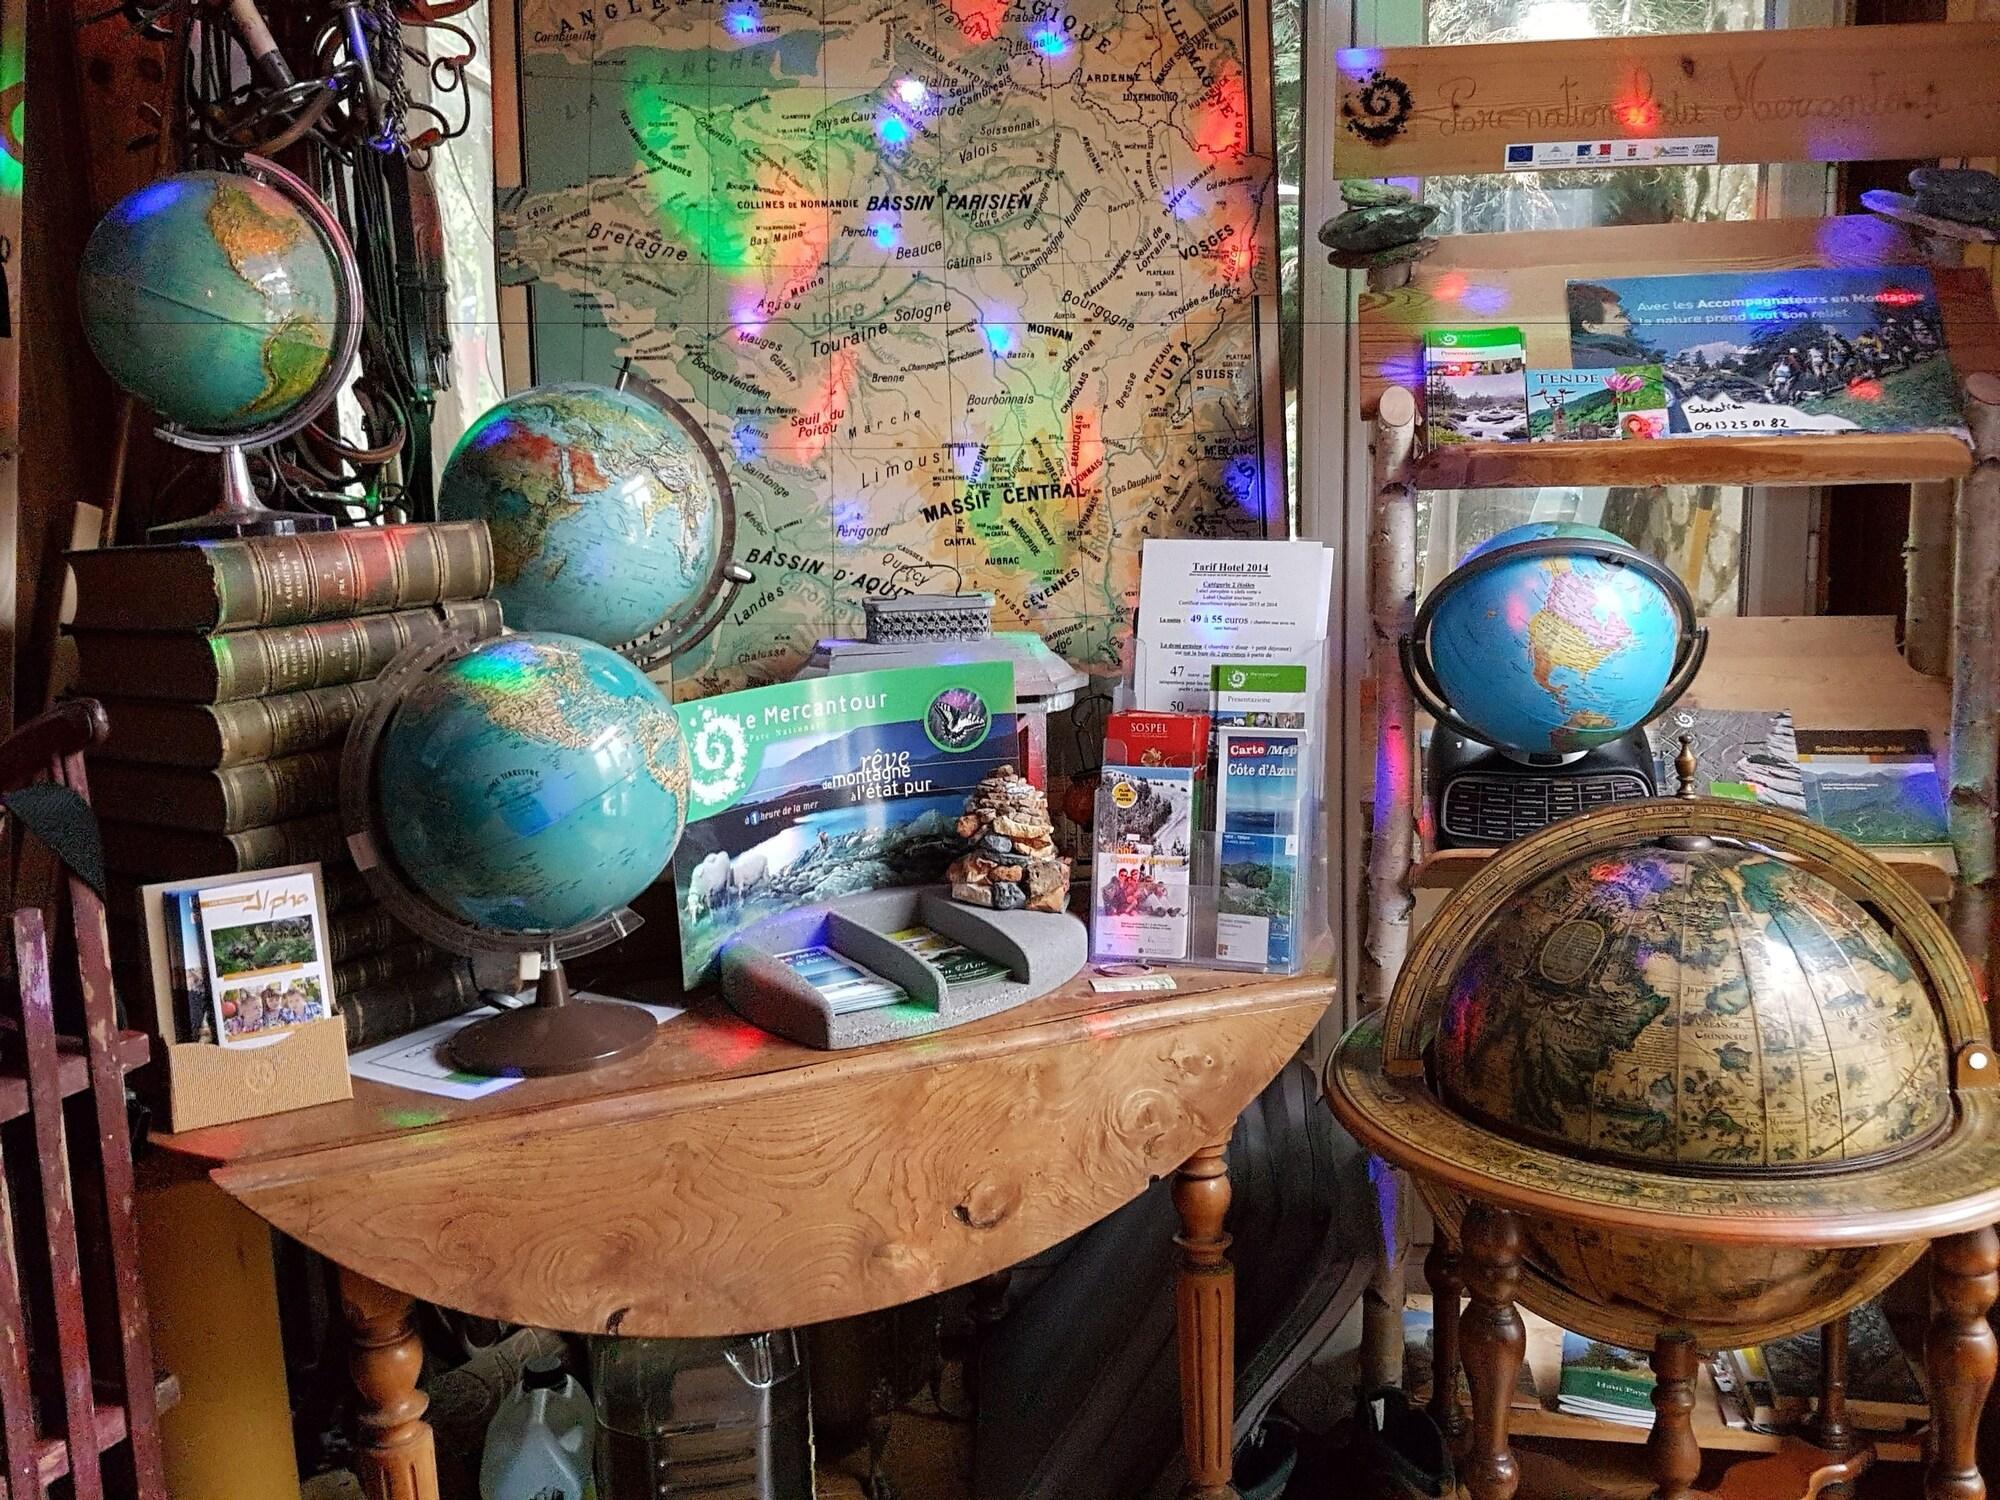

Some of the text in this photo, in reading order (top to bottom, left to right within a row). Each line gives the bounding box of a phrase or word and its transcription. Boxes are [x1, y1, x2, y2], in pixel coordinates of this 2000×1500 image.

[904, 32, 945, 62] PLATEAU
[1087, 74, 1141, 82] ARDENNE
[950, 81, 975, 98] Seuil
[816, 111, 878, 132] Pays de Caux
[980, 118, 1041, 136] Soissonnais
[959, 143, 998, 165] Valois
[1082, 135, 1104, 174] ARGONNE
[737, 200, 785, 209] COLLINES
[800, 200, 859, 208] NORMANDIE
[866, 193, 1033, 212] BASSIN PARISIEN
[1023, 182, 1051, 231] Champagne
[970, 209, 998, 222] Brie
[841, 225, 878, 238] Perche
[1019, 188, 1091, 280] Champagne Humide
[586, 223, 688, 262] Bretagne
[896, 239, 942, 260] Beauce
[1178, 224, 1235, 261] VOSGES
[946, 251, 993, 270] Gâtinais
[757, 298, 802, 312] Anjou
[894, 300, 952, 323] Sologne
[1062, 289, 1135, 332] Bourgogne
[1637, 291, 1926, 312] Avec les Accompagnateurs en Montagne
[1655, 314, 1702, 325] nature
[1704, 311, 1747, 326] prend
[1749, 310, 1782, 322] tout
[1783, 310, 1809, 321] son
[738, 331, 783, 352] Mauges
[811, 322, 888, 357] Touraine
[1027, 322, 1073, 342] MORVAN
[691, 355, 729, 382] Bocage
[872, 373, 905, 384] Brenne
[1157, 339, 1193, 397] JURA
[1536, 373, 1600, 385] TENDE
[967, 394, 1034, 406] Bourbonnais
[1115, 371, 1137, 409] Bresse
[791, 408, 844, 428] Seuil du
[1695, 417, 1790, 431] 06 13 25 01 82
[799, 423, 838, 439] Poitou
[862, 447, 966, 489] Limousin
[742, 462, 790, 499] Saintonge
[922, 482, 1086, 524] MASSIF CENTRAL
[836, 523, 890, 540] Périgord
[943, 537, 977, 547] CANTAL
[1008, 517, 1041, 557] MARGERIDE
[745, 548, 825, 576] BASSIN
[985, 556, 1020, 566] AUBRAC
[1192, 562, 1269, 573] Tarif Hotel 2014
[1022, 567, 1080, 609] CÉVENNES
[734, 585, 784, 627] Landes
[994, 587, 1031, 626] CAUSSES
[1190, 614, 1202, 624] 49
[1211, 614, 1223, 624] 55
[1224, 616, 1249, 625] euros
[1170, 665, 1185, 678] 47
[739, 691, 888, 730] Le Mercantour
[1170, 700, 1184, 712] 50
[1131, 722, 1168, 733] SOSPEL
[860, 748, 910, 772] rêve
[1230, 745, 1264, 756] Carte
[822, 764, 912, 790] de montagne
[1228, 763, 1297, 777] Côte d'Azur
[856, 782, 899, 802] l'état
[904, 778, 933, 798] pur
[782, 804, 792, 816] de
